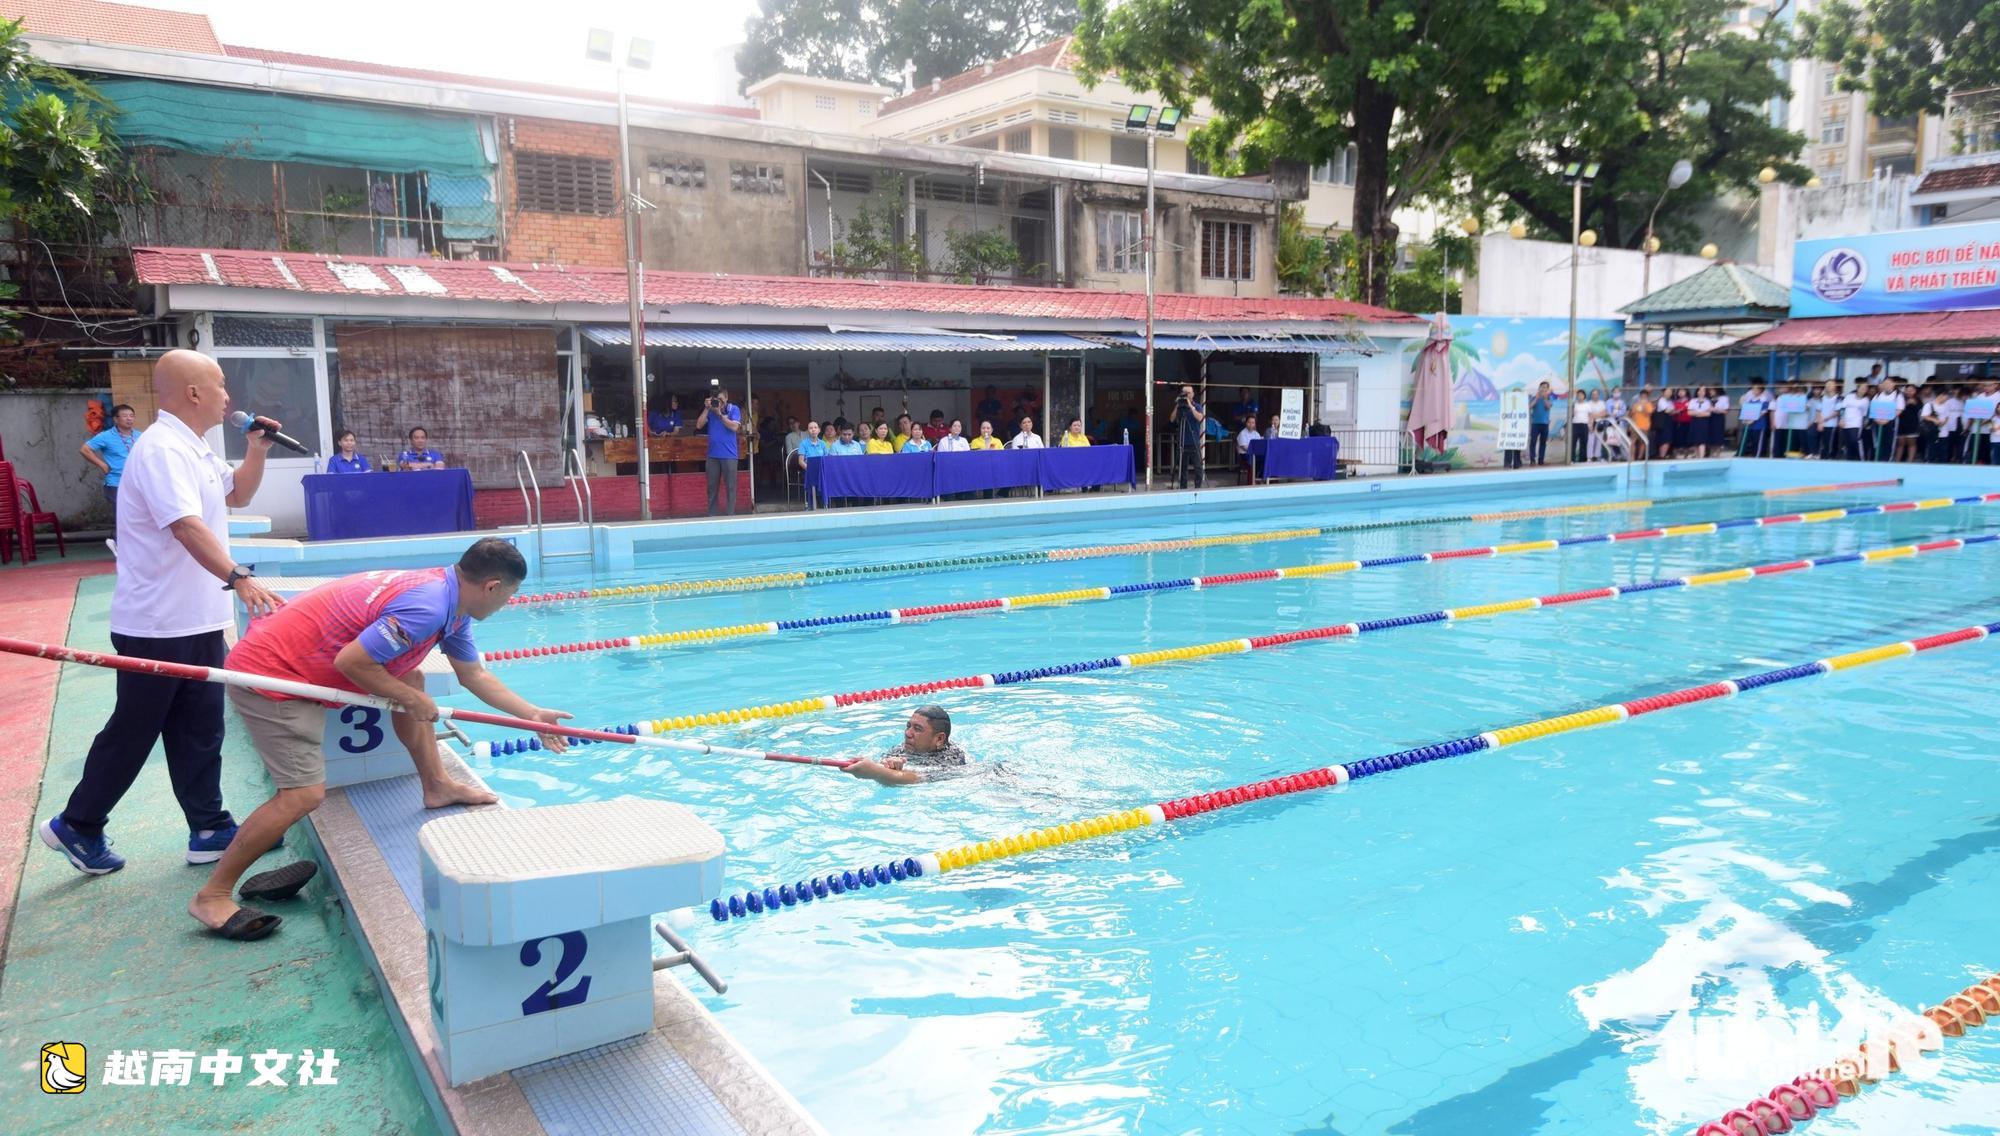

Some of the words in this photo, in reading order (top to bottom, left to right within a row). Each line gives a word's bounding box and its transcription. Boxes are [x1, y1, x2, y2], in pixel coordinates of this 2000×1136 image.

[1892, 251, 1920, 268] HỌC
[1926, 247, 1950, 264] BƠI
[1887, 273, 1904, 290] VÀ
[339, 704, 384, 753] 3
[520, 930, 592, 1016] 2
